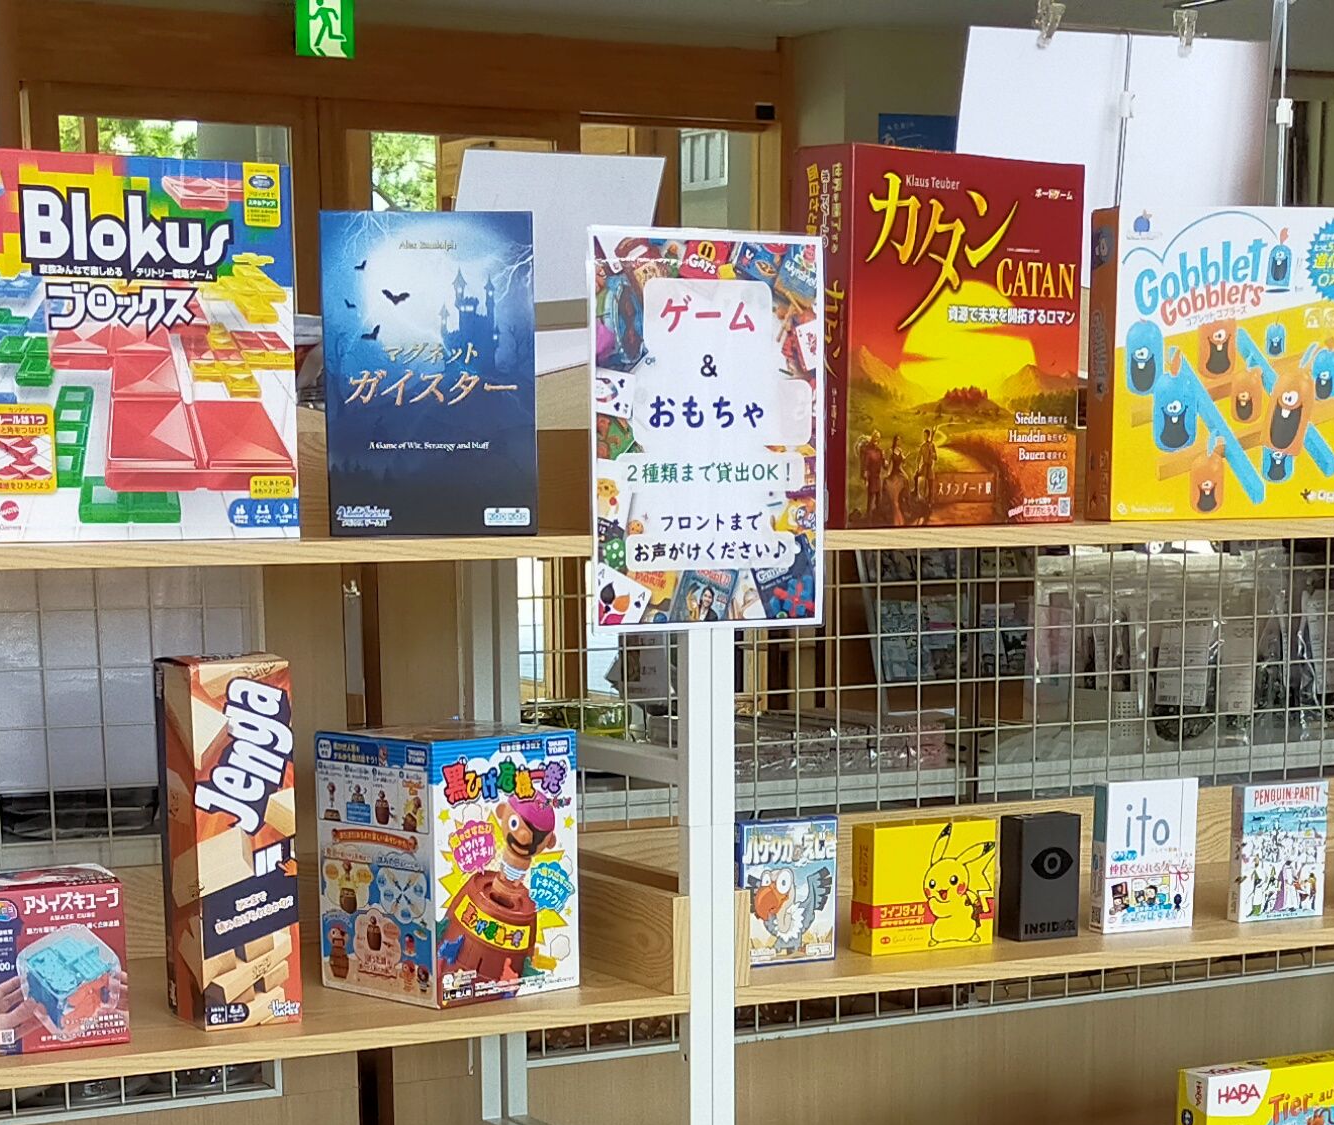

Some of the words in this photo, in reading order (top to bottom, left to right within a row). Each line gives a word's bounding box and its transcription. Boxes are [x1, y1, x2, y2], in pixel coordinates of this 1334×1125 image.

[905, 175, 930, 189] Klaus
[931, 177, 960, 191] Teuber
[21, 187, 231, 271] Blokus
[866, 172, 1019, 332] カタン
[996, 257, 1076, 300] CATAN
[1134, 239, 1268, 315] Gobblet
[47, 282, 197, 336] ブロックス
[660, 294, 755, 333] ゲーム
[947, 305, 1076, 327] 資源で未来を開拓するロマン
[1160, 281, 1264, 327] Gobblers
[385, 342, 479, 364] マグネット
[700, 354, 718, 378] &
[343, 369, 518, 407] ガイスター
[649, 395, 765, 429] おもちゃ
[1015, 411, 1046, 425] Siedeln
[376, 441, 397, 449] Game
[1009, 429, 1046, 443] Handeln
[1018, 447, 1046, 461] Bauen
[660, 511, 763, 531] フロントまで
[195, 678, 293, 833] Jenga
[1254, 787, 1293, 806] PENGUIN
[1295, 785, 1321, 803] PARTY
[1126, 797, 1170, 856] ito
[23, 888, 119, 915] アメイズキューブ
[879, 904, 925, 918] ナインタイル
[1218, 1083, 1261, 1105] HABA
